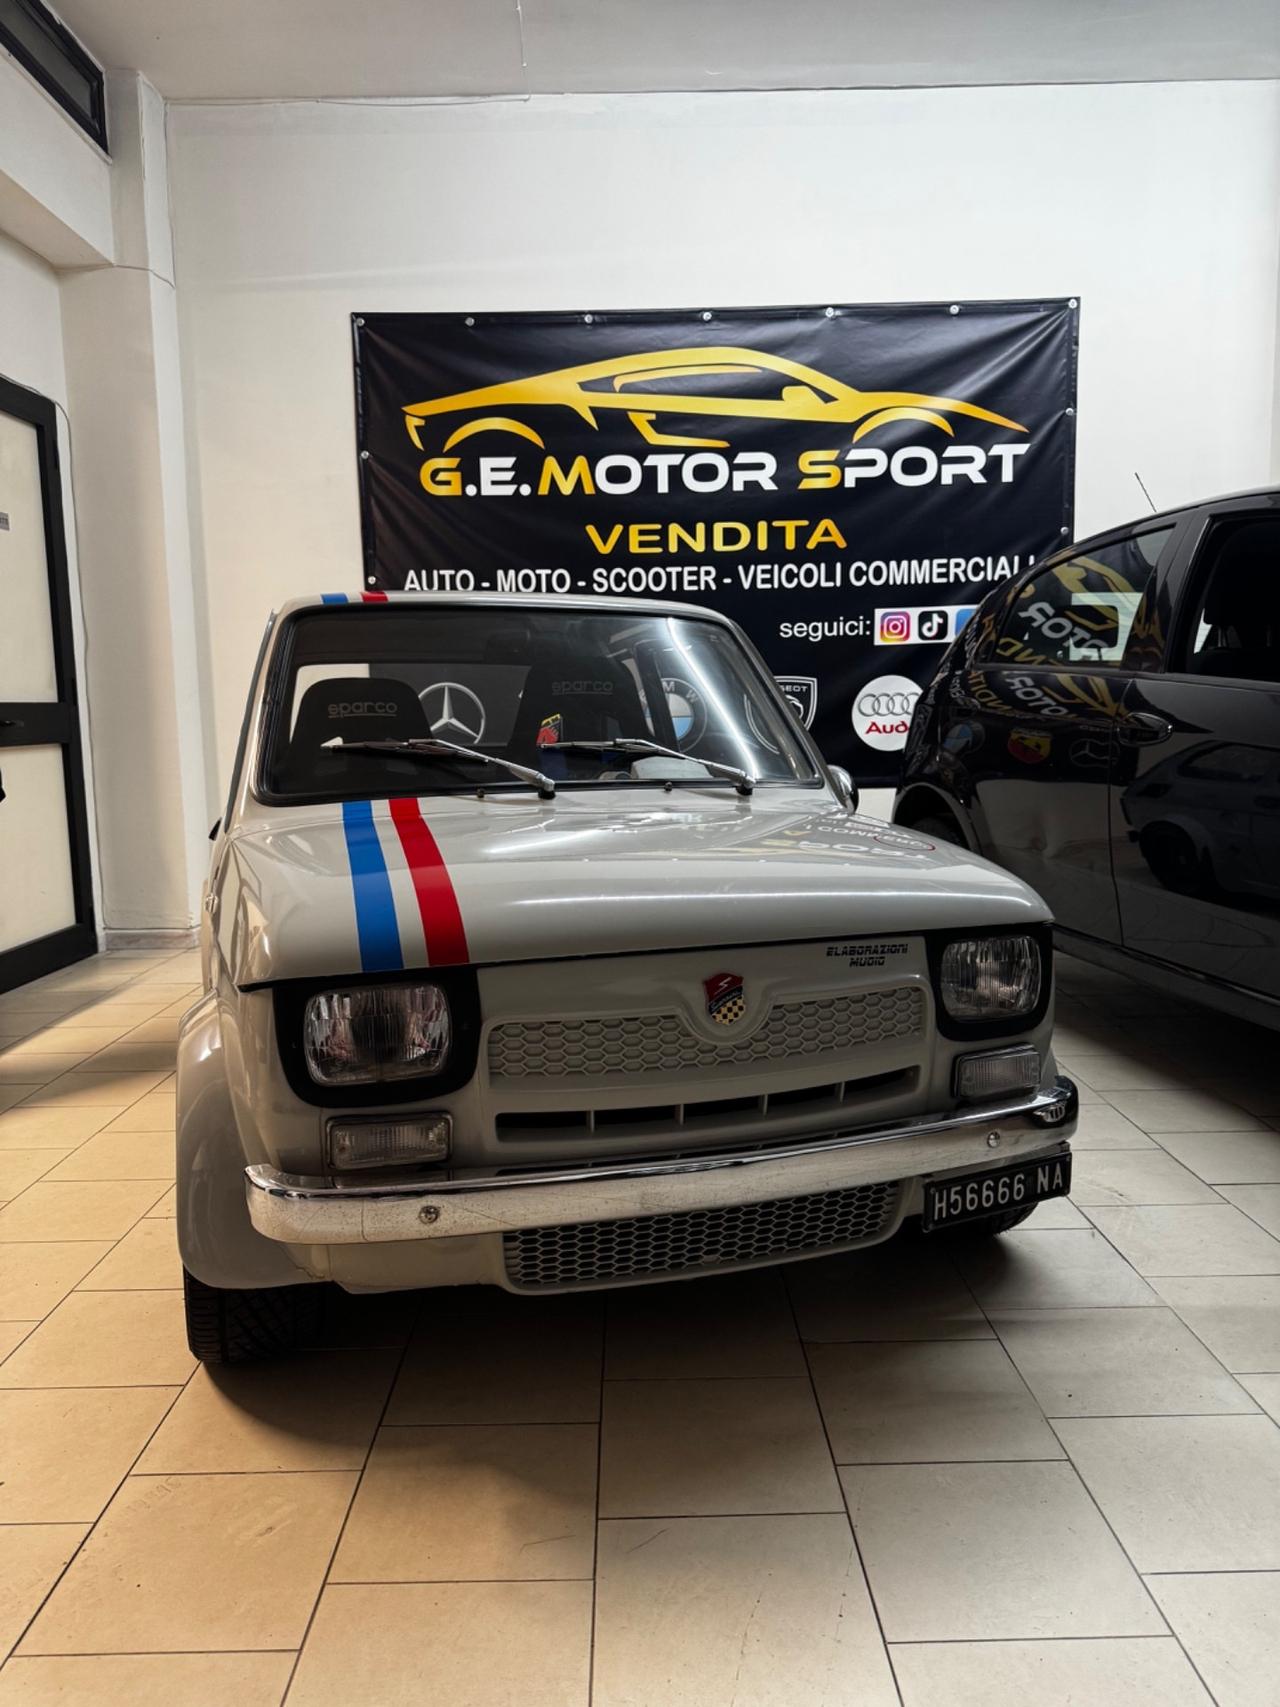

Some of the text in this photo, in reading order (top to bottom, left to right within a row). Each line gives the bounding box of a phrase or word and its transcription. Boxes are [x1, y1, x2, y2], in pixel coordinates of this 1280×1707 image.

[797, 443, 1031, 490] SPORT
[585, 519, 848, 555] VENDITA
[404, 569, 475, 591] AUTO
[496, 568, 571, 593] MOTO
[592, 565, 717, 593] SCOOTER
[738, 562, 842, 590] VEICOLI
[779, 615, 871, 642] seguici:
[865, 720, 909, 734] Aud
[826, 943, 909, 957] ELABORAZIONI
[934, 1163, 1063, 1221] H56666 NA
